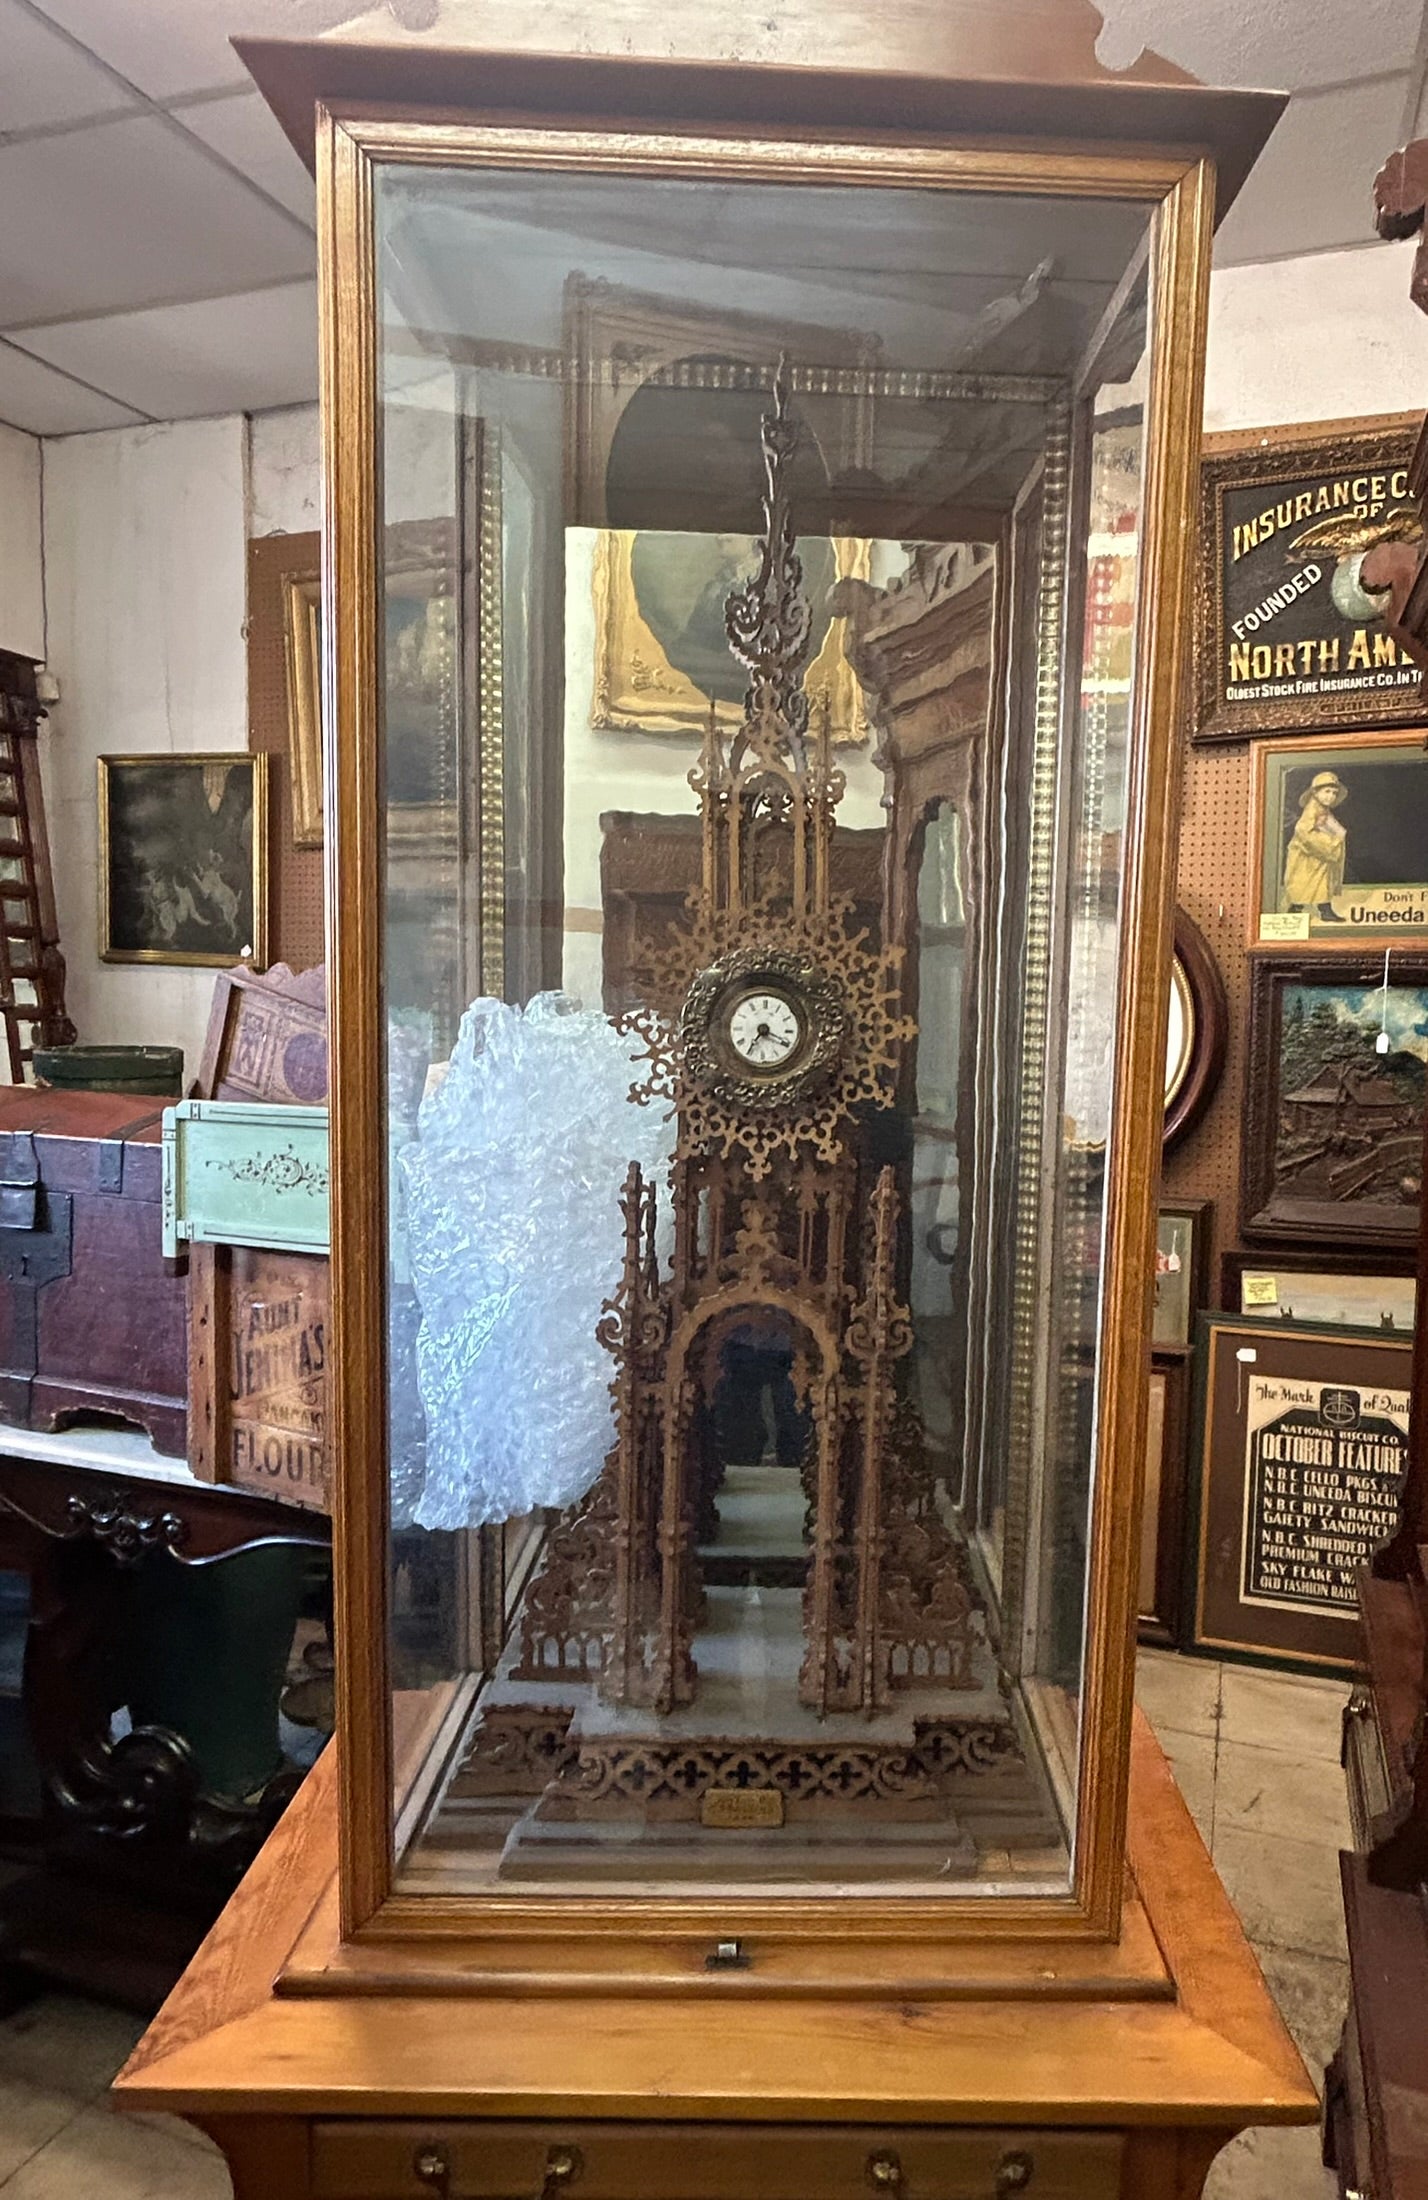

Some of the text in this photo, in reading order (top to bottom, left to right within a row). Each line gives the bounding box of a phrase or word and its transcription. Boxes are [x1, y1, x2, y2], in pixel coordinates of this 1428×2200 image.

[1232, 470, 1415, 562] INSURANCE C
[1353, 501, 1384, 519] OF
[1231, 563, 1322, 641] FOUNDED
[1228, 629, 1415, 682] NORTH AM
[1226, 686, 1260, 700] OLDEST
[1262, 682, 1295, 698] STOCK
[1296, 680, 1319, 694] FIRE
[1320, 676, 1375, 692] INSURANCE
[1377, 673, 1397, 686] CO.
[1397, 671, 1410, 684] IN
[1384, 890, 1413, 902] Don't
[1350, 906, 1424, 923] Uneeda
[1256, 1384, 1277, 1400] The
[1280, 1385, 1314, 1404] Mark
[1364, 1395, 1376, 1409] of
[1381, 1395, 1410, 1413] Qual
[1280, 1423, 1335, 1439] NATIONAL
[1339, 1431, 1379, 1443] BISCUIT
[1262, 1433, 1408, 1474] OCTOBER FEATURE
[1303, 1470, 1339, 1486] CELLO
[1303, 1484, 1351, 1502] UNEEDA
[1357, 1490, 1398, 1507] BISCUI
[1264, 1511, 1311, 1528] GAIETY
[1303, 1502, 1333, 1517] RITZ
[1341, 1506, 1397, 1526] CRACKER
[1303, 1534, 1366, 1554] SHREDDED
[1262, 1544, 1370, 1567] PREMIUM CRACK
[1260, 1576, 1281, 1589] OLD
[1261, 1561, 1288, 1575] SKY
[1293, 1565, 1332, 1582] FLAKE
